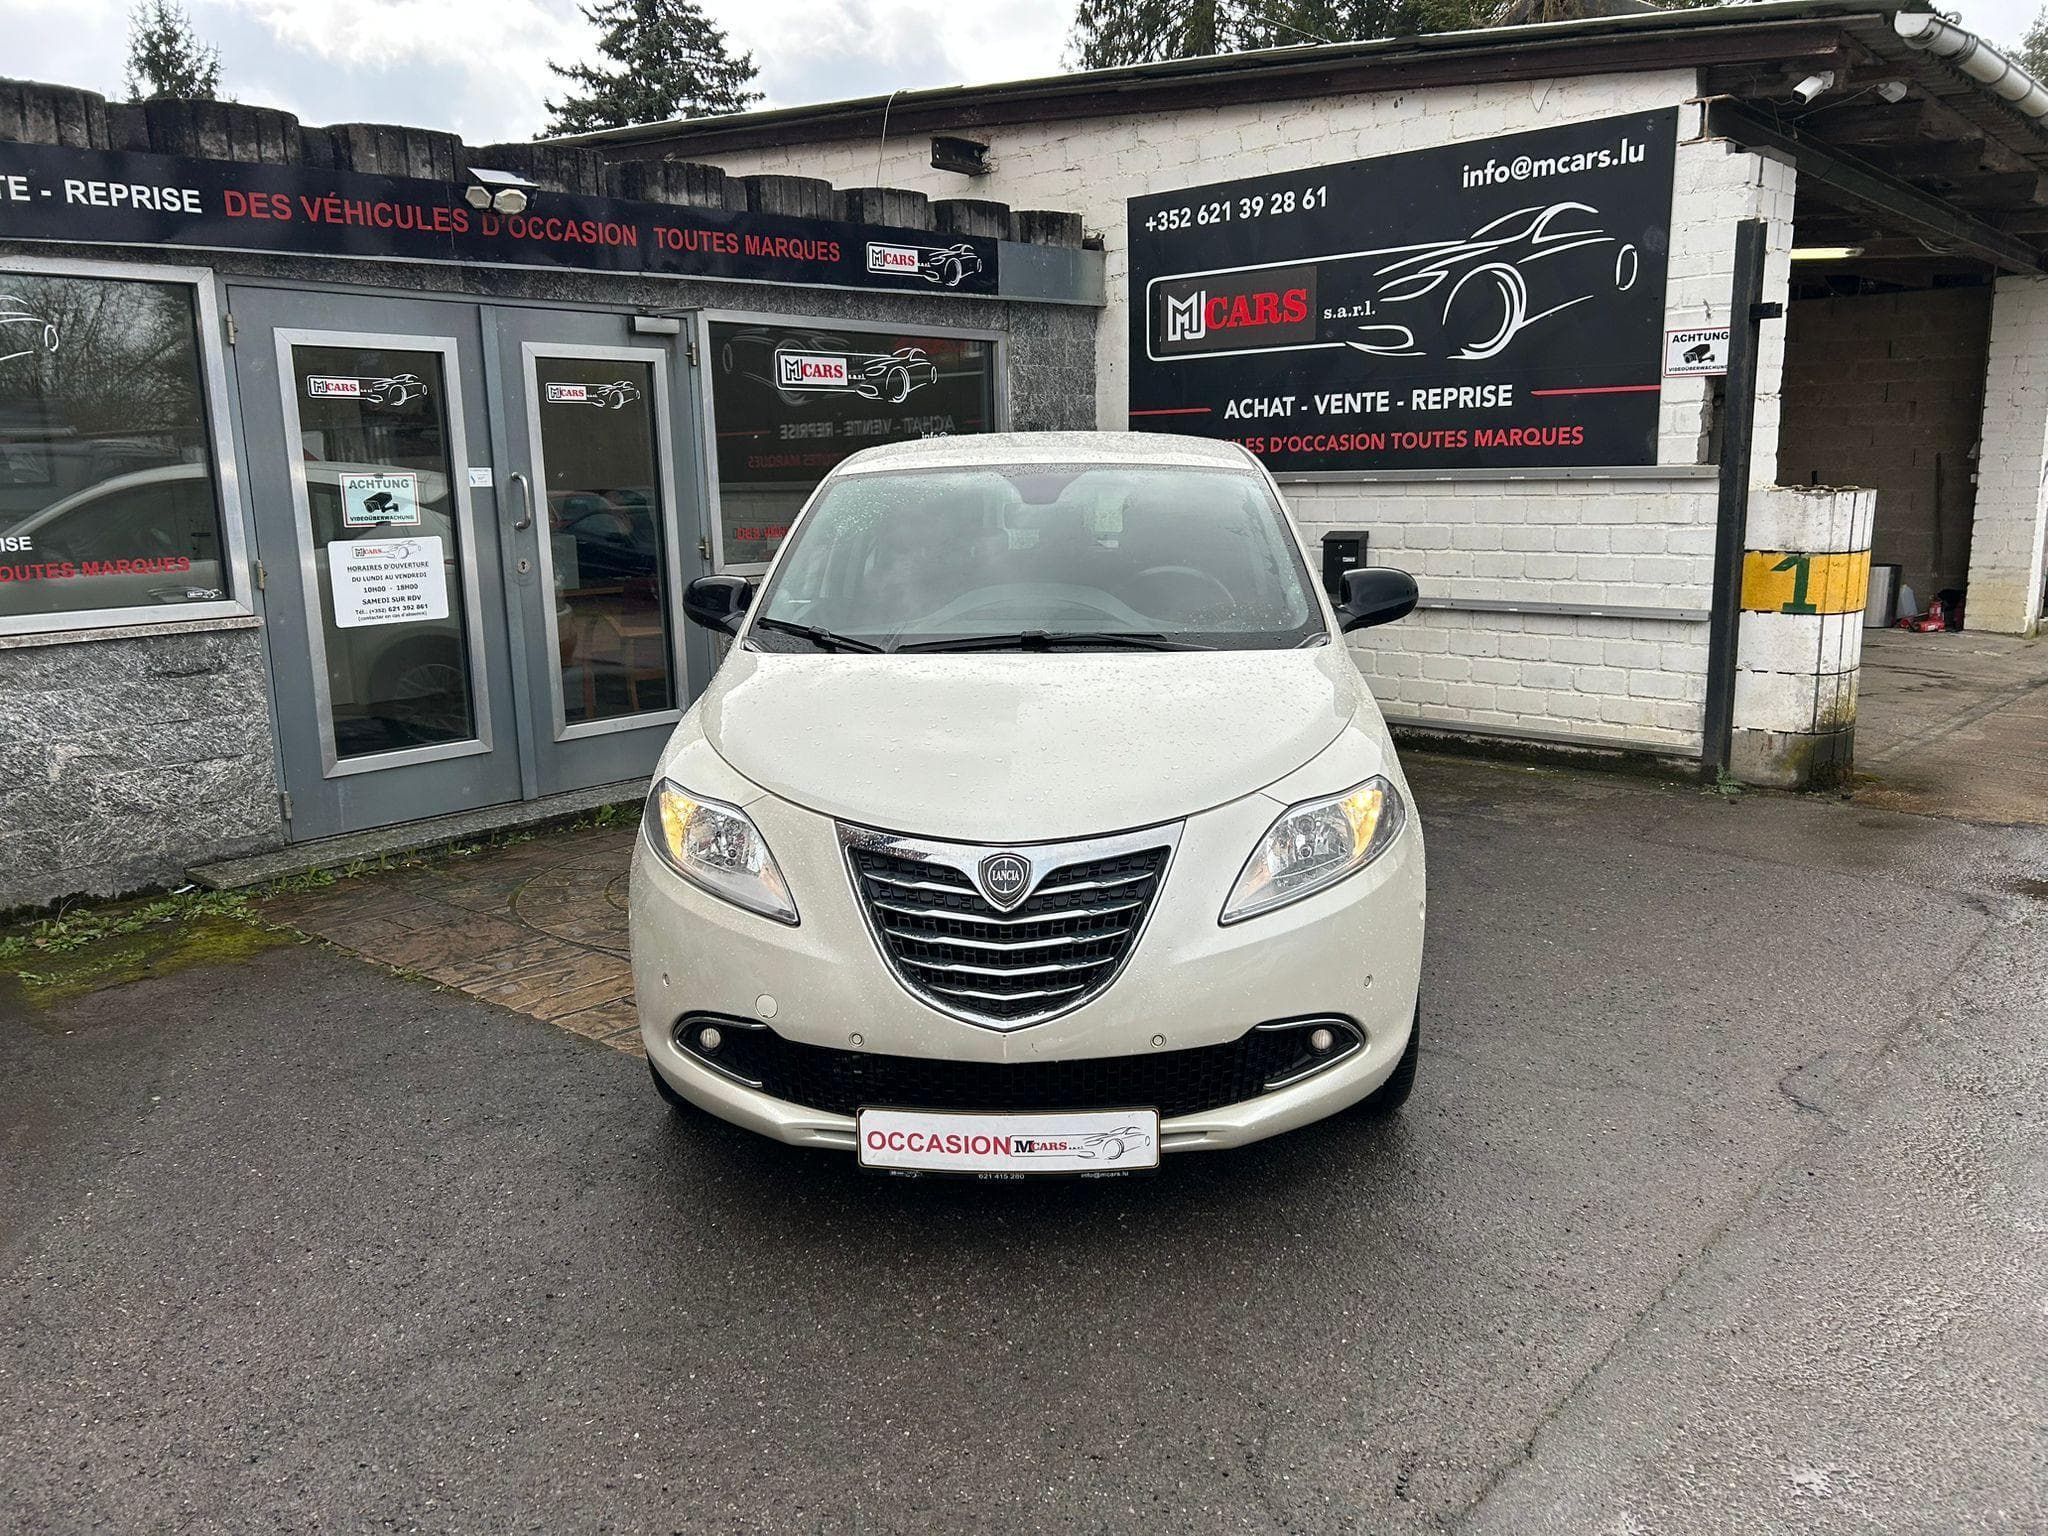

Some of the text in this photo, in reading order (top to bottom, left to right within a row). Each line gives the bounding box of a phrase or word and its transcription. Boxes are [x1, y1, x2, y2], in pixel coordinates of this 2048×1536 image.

[1463, 138, 1645, 188] info@mcars.lu
[1145, 186, 1328, 231] +352 621 39 28 61
[64, 179, 203, 214] REPRISE
[224, 190, 293, 220] DES
[300, 191, 469, 233] VÉHICULES
[480, 214, 639, 247] D'OCCASION
[653, 226, 739, 254] TOUTES
[745, 234, 841, 263] MARQUES
[1323, 301, 1376, 319] s.a.r.l.
[1672, 331, 1729, 343] ACHTUNG
[1223, 396, 1296, 420] ACHAT
[1314, 391, 1390, 416] VENTE
[1411, 384, 1513, 411] REPRISE
[1270, 432, 1385, 453] D'OCCASION
[1391, 429, 1469, 449] TOUTES
[1474, 425, 1584, 447] MARQUES
[349, 479, 409, 489] ACHTUNG
[81, 556, 191, 576] MARQUES
[347, 561, 429, 573] HORAIRES D'OUVERTURE
[395, 571, 427, 580] VENDREDI
[1770, 556, 1816, 614] 1
[362, 594, 421, 606] SAMEDI SUR RDV
[992, 870, 1019, 881] LANCIA
[867, 1131, 1011, 1155] OCCASION
